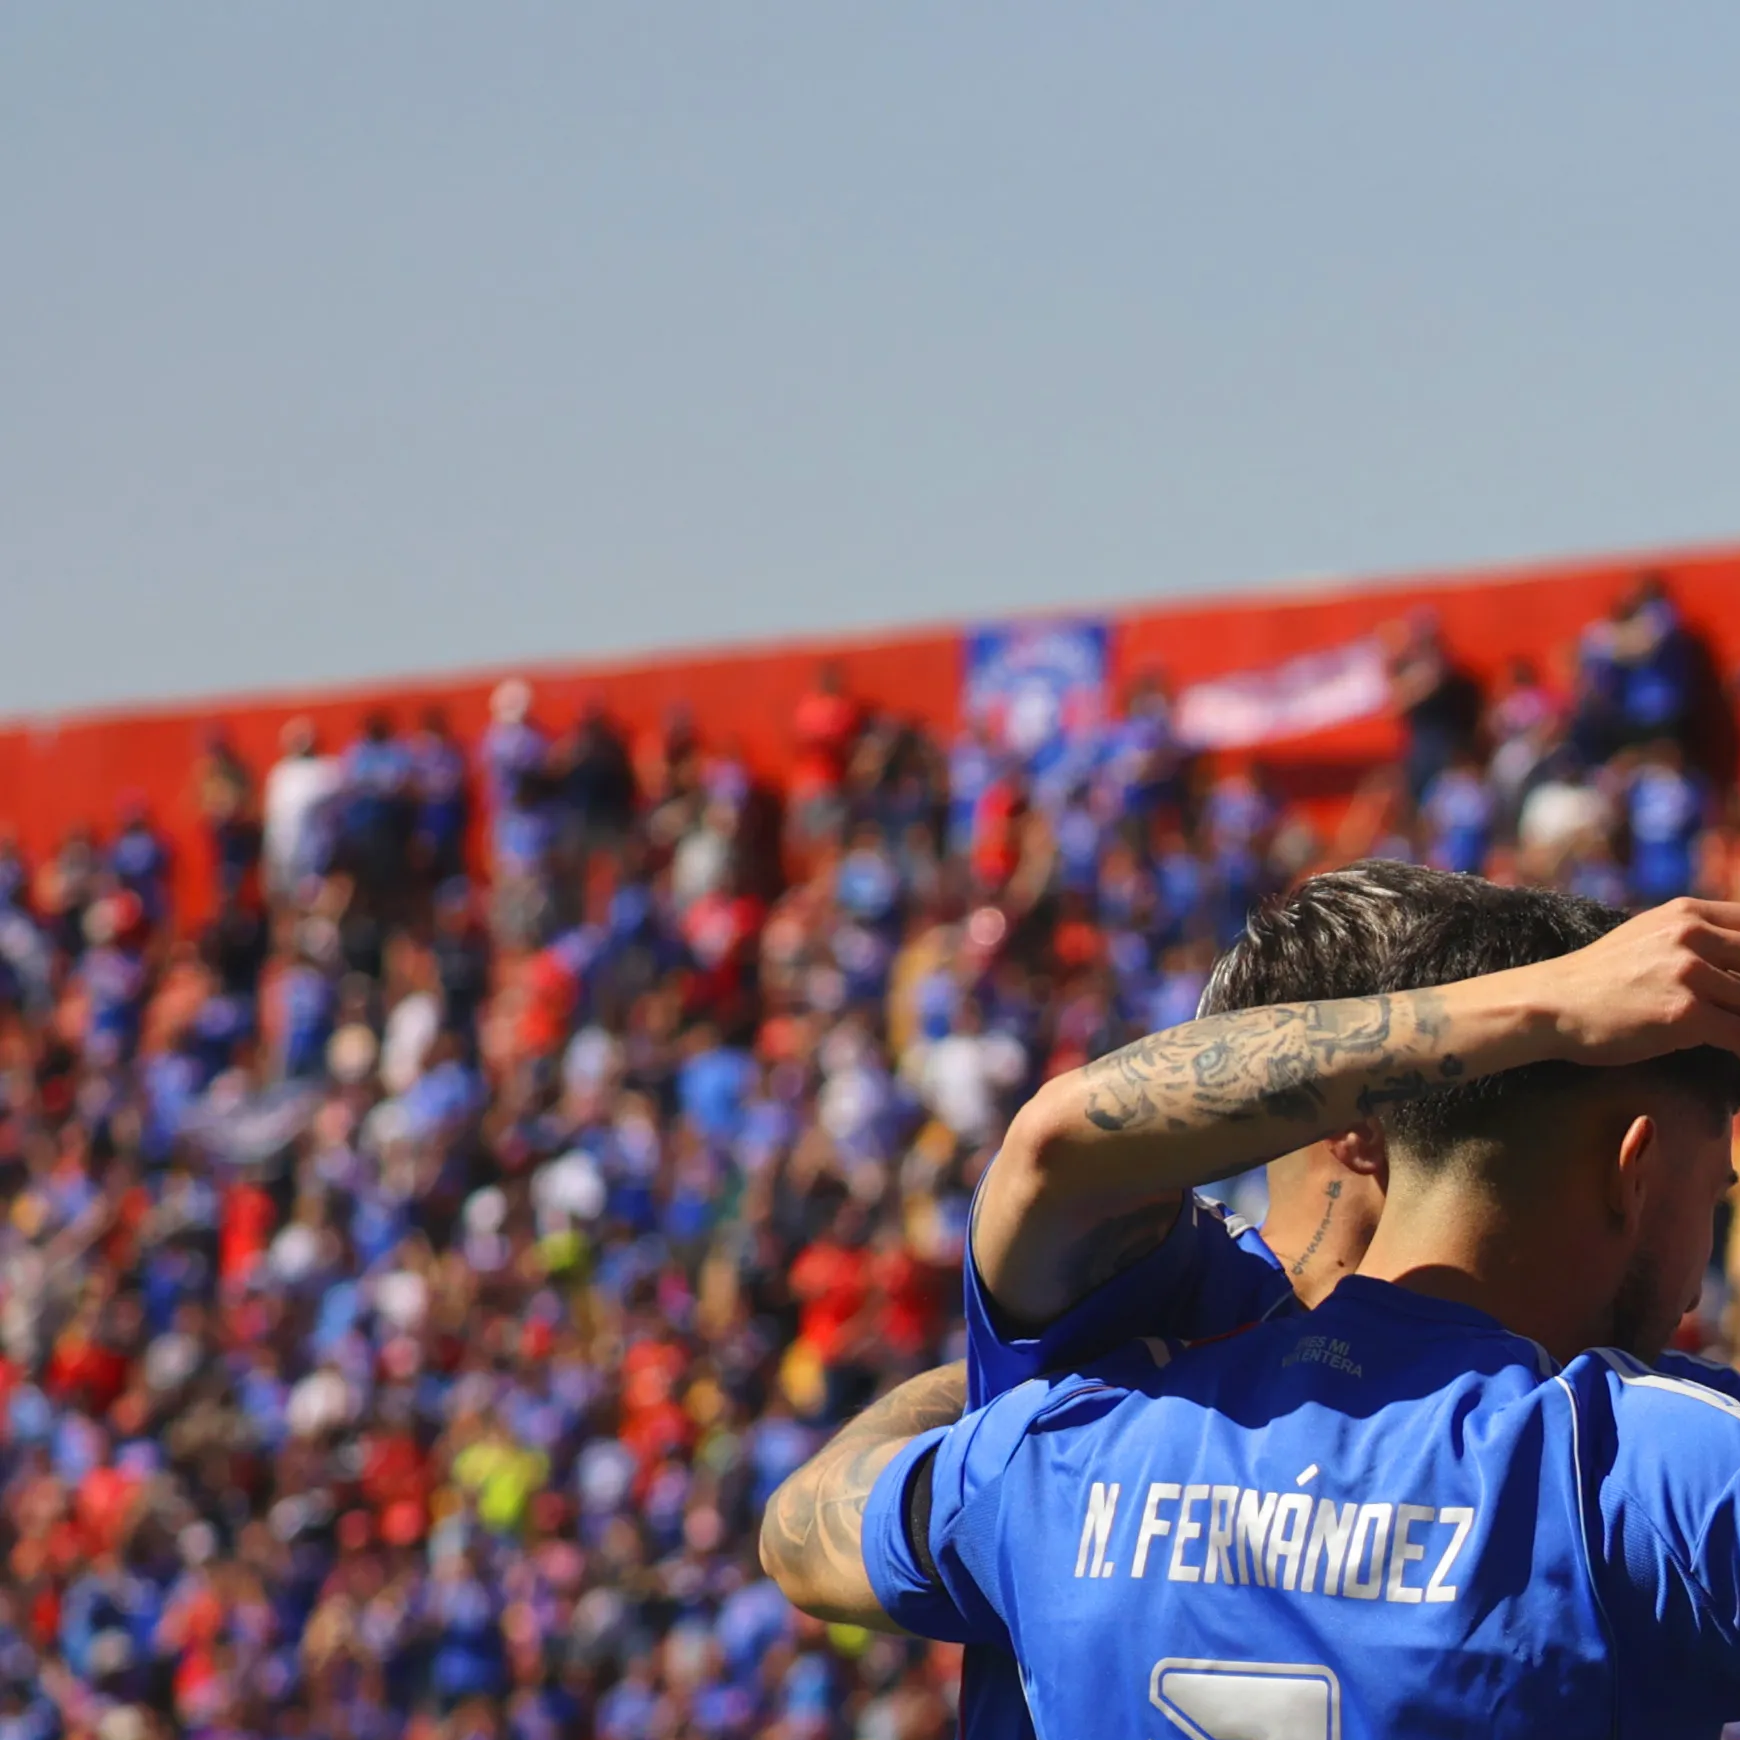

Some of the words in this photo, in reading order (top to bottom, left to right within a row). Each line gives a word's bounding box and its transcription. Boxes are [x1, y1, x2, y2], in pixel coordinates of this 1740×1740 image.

[1301, 1349, 1363, 1378] ENTERA
[1074, 1482, 1121, 1578] N.
[1130, 1463, 1475, 1603] FERNÁNDEZ
